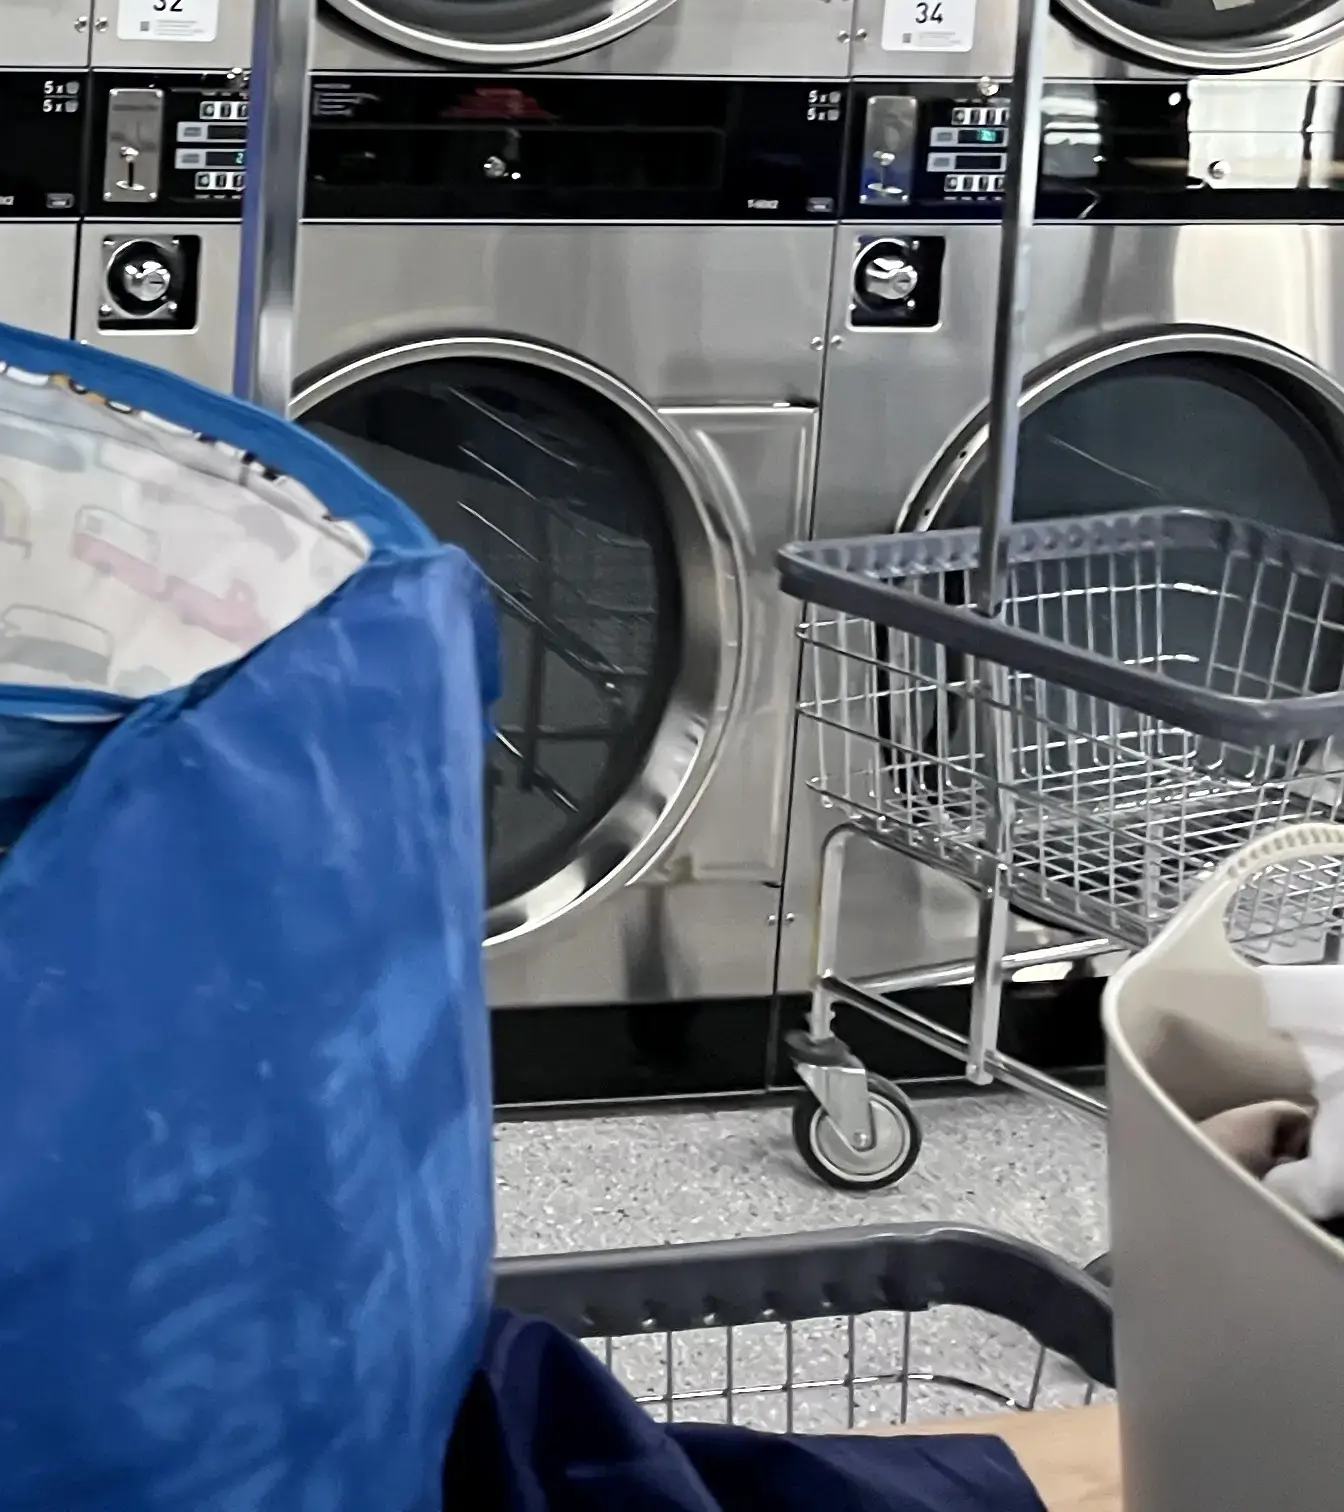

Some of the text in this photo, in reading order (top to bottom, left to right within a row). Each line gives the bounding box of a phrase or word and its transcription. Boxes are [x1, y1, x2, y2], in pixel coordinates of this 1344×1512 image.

[915, 2, 943, 24] 34
[44, 80, 55, 96] 5
[808, 90, 819, 105] 5
[43, 99, 54, 114] 5
[807, 107, 817, 122] 5
